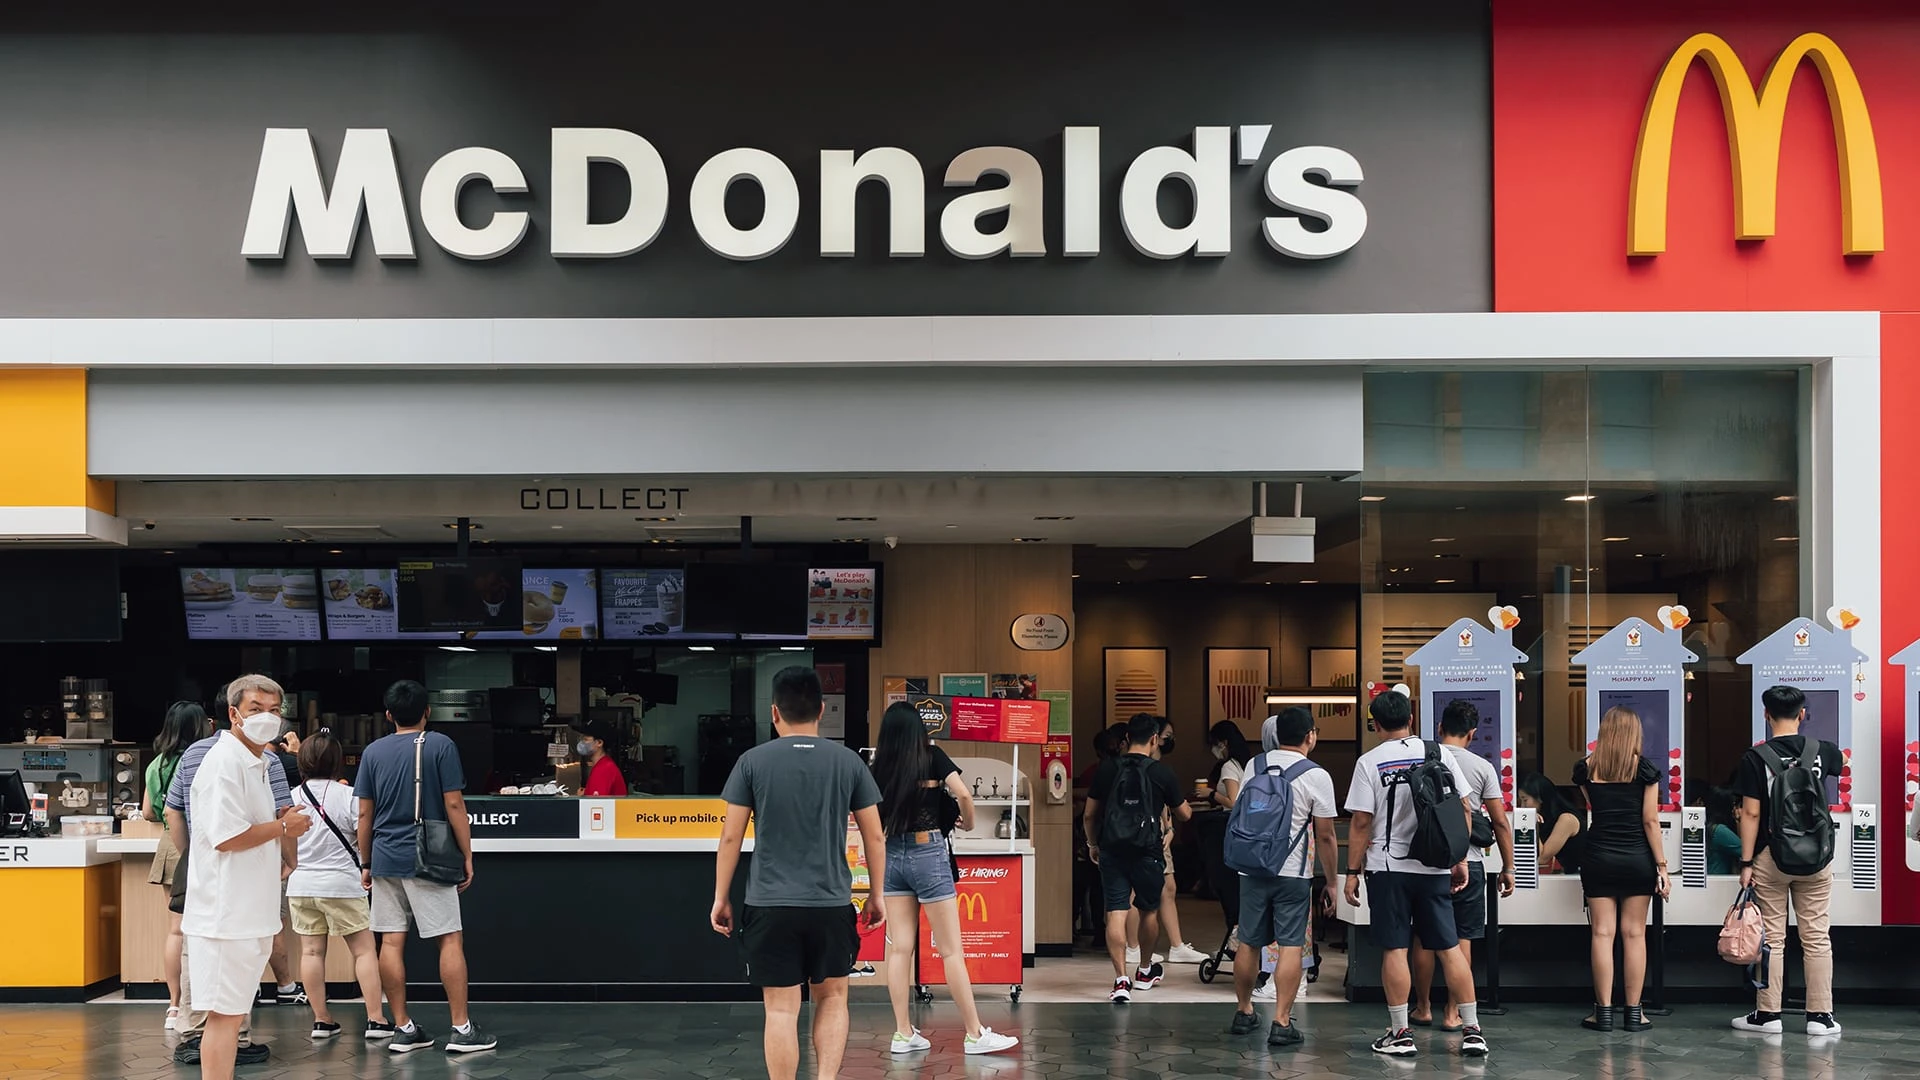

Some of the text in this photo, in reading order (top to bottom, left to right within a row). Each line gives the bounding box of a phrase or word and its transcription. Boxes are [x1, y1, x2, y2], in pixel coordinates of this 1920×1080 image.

[240, 124, 1368, 260] McDonald's
[520, 488, 690, 510] COLLECT
[466, 813, 519, 825] OLLECT
[636, 813, 660, 823] Pick
[662, 815, 677, 825] up
[679, 813, 718, 823] mobile
[0, 846, 29, 862] ER
[970, 867, 1009, 879] HIRING!
